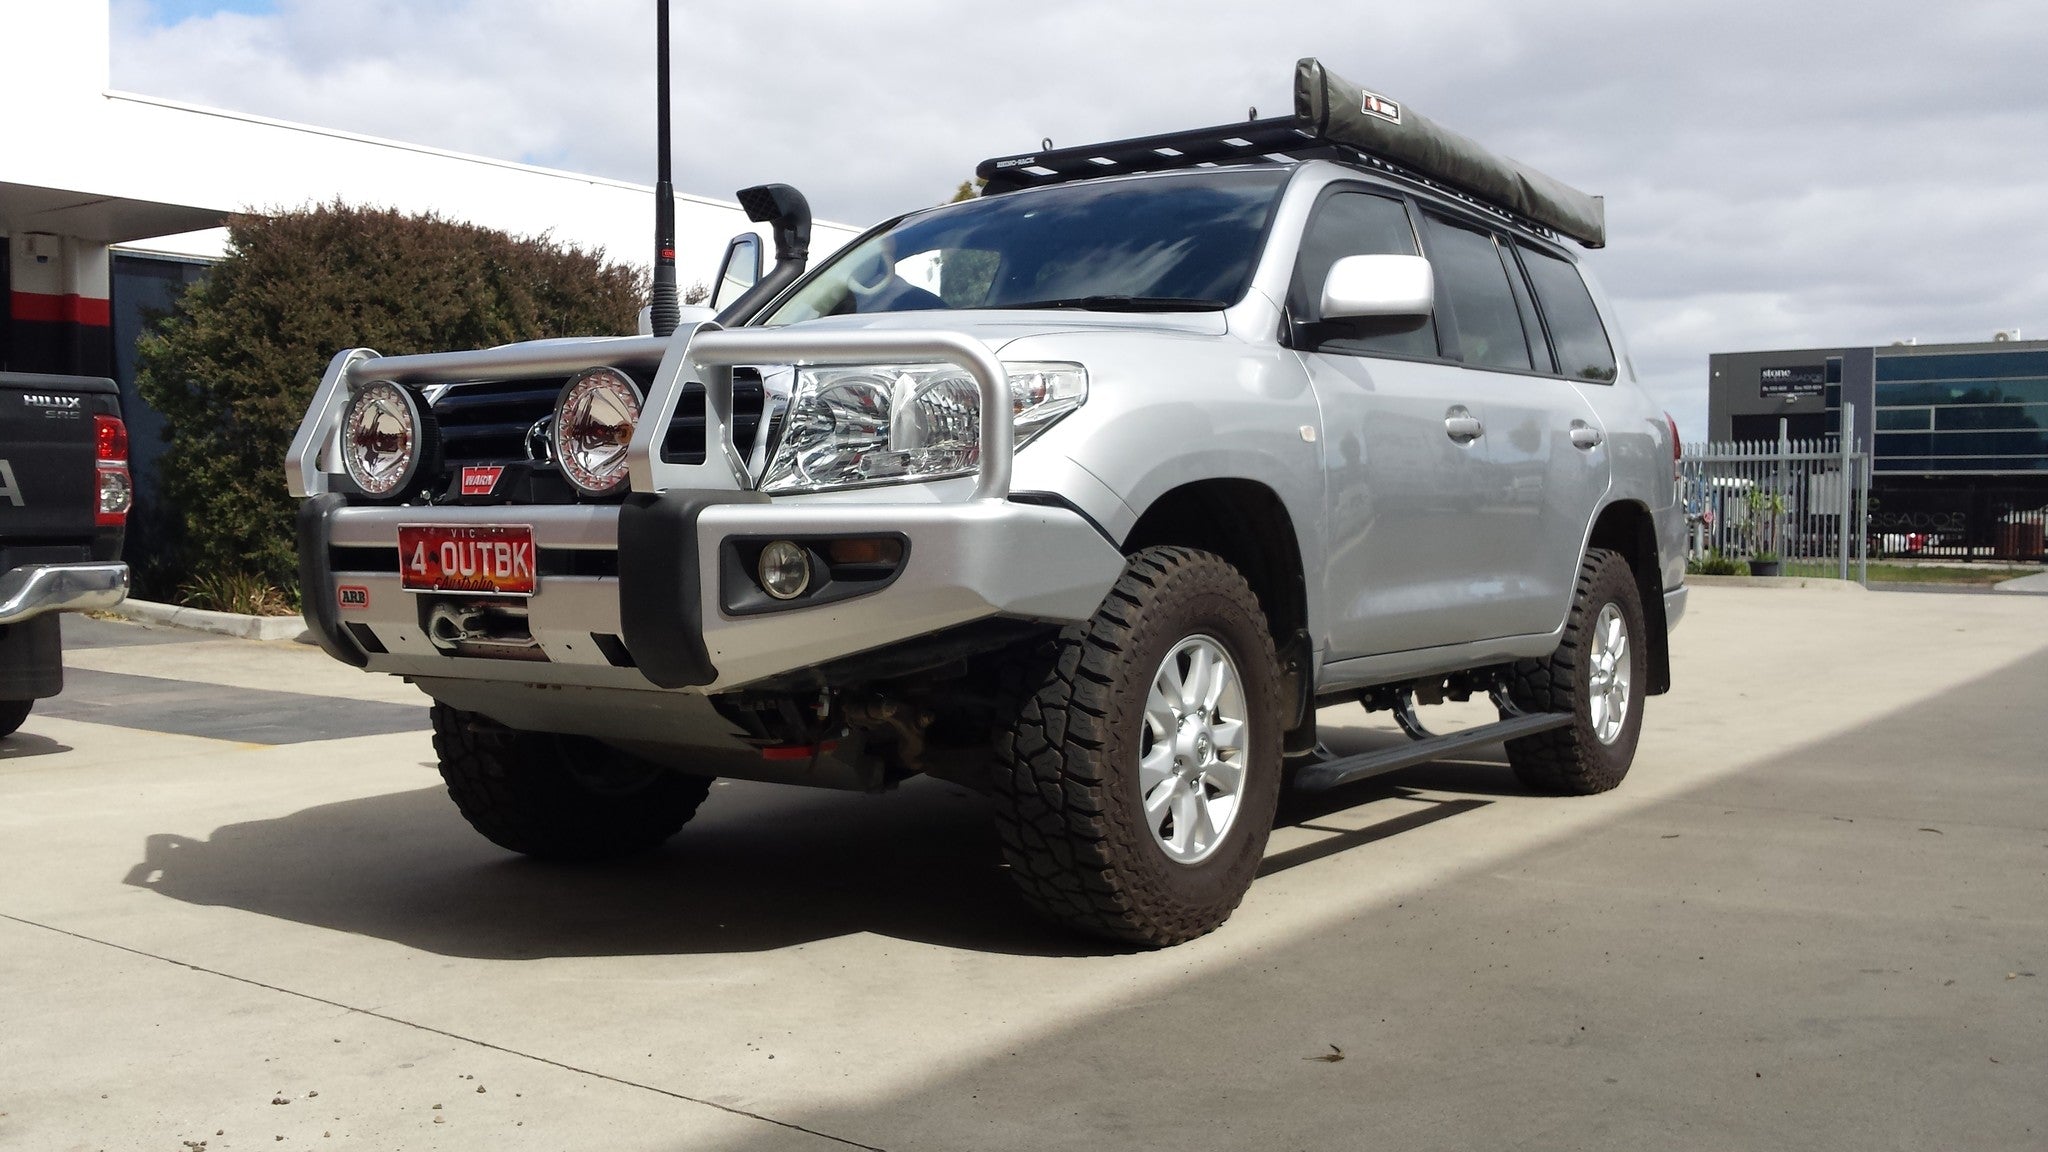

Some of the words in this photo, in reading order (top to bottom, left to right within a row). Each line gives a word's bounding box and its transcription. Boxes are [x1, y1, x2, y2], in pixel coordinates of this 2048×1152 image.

[23, 394, 81, 408] HILUX
[465, 474, 495, 486] WARN
[451, 528, 476, 538] VIC
[410, 541, 428, 576] 4
[440, 541, 530, 578] OUTBK
[342, 590, 366, 604] ARB
